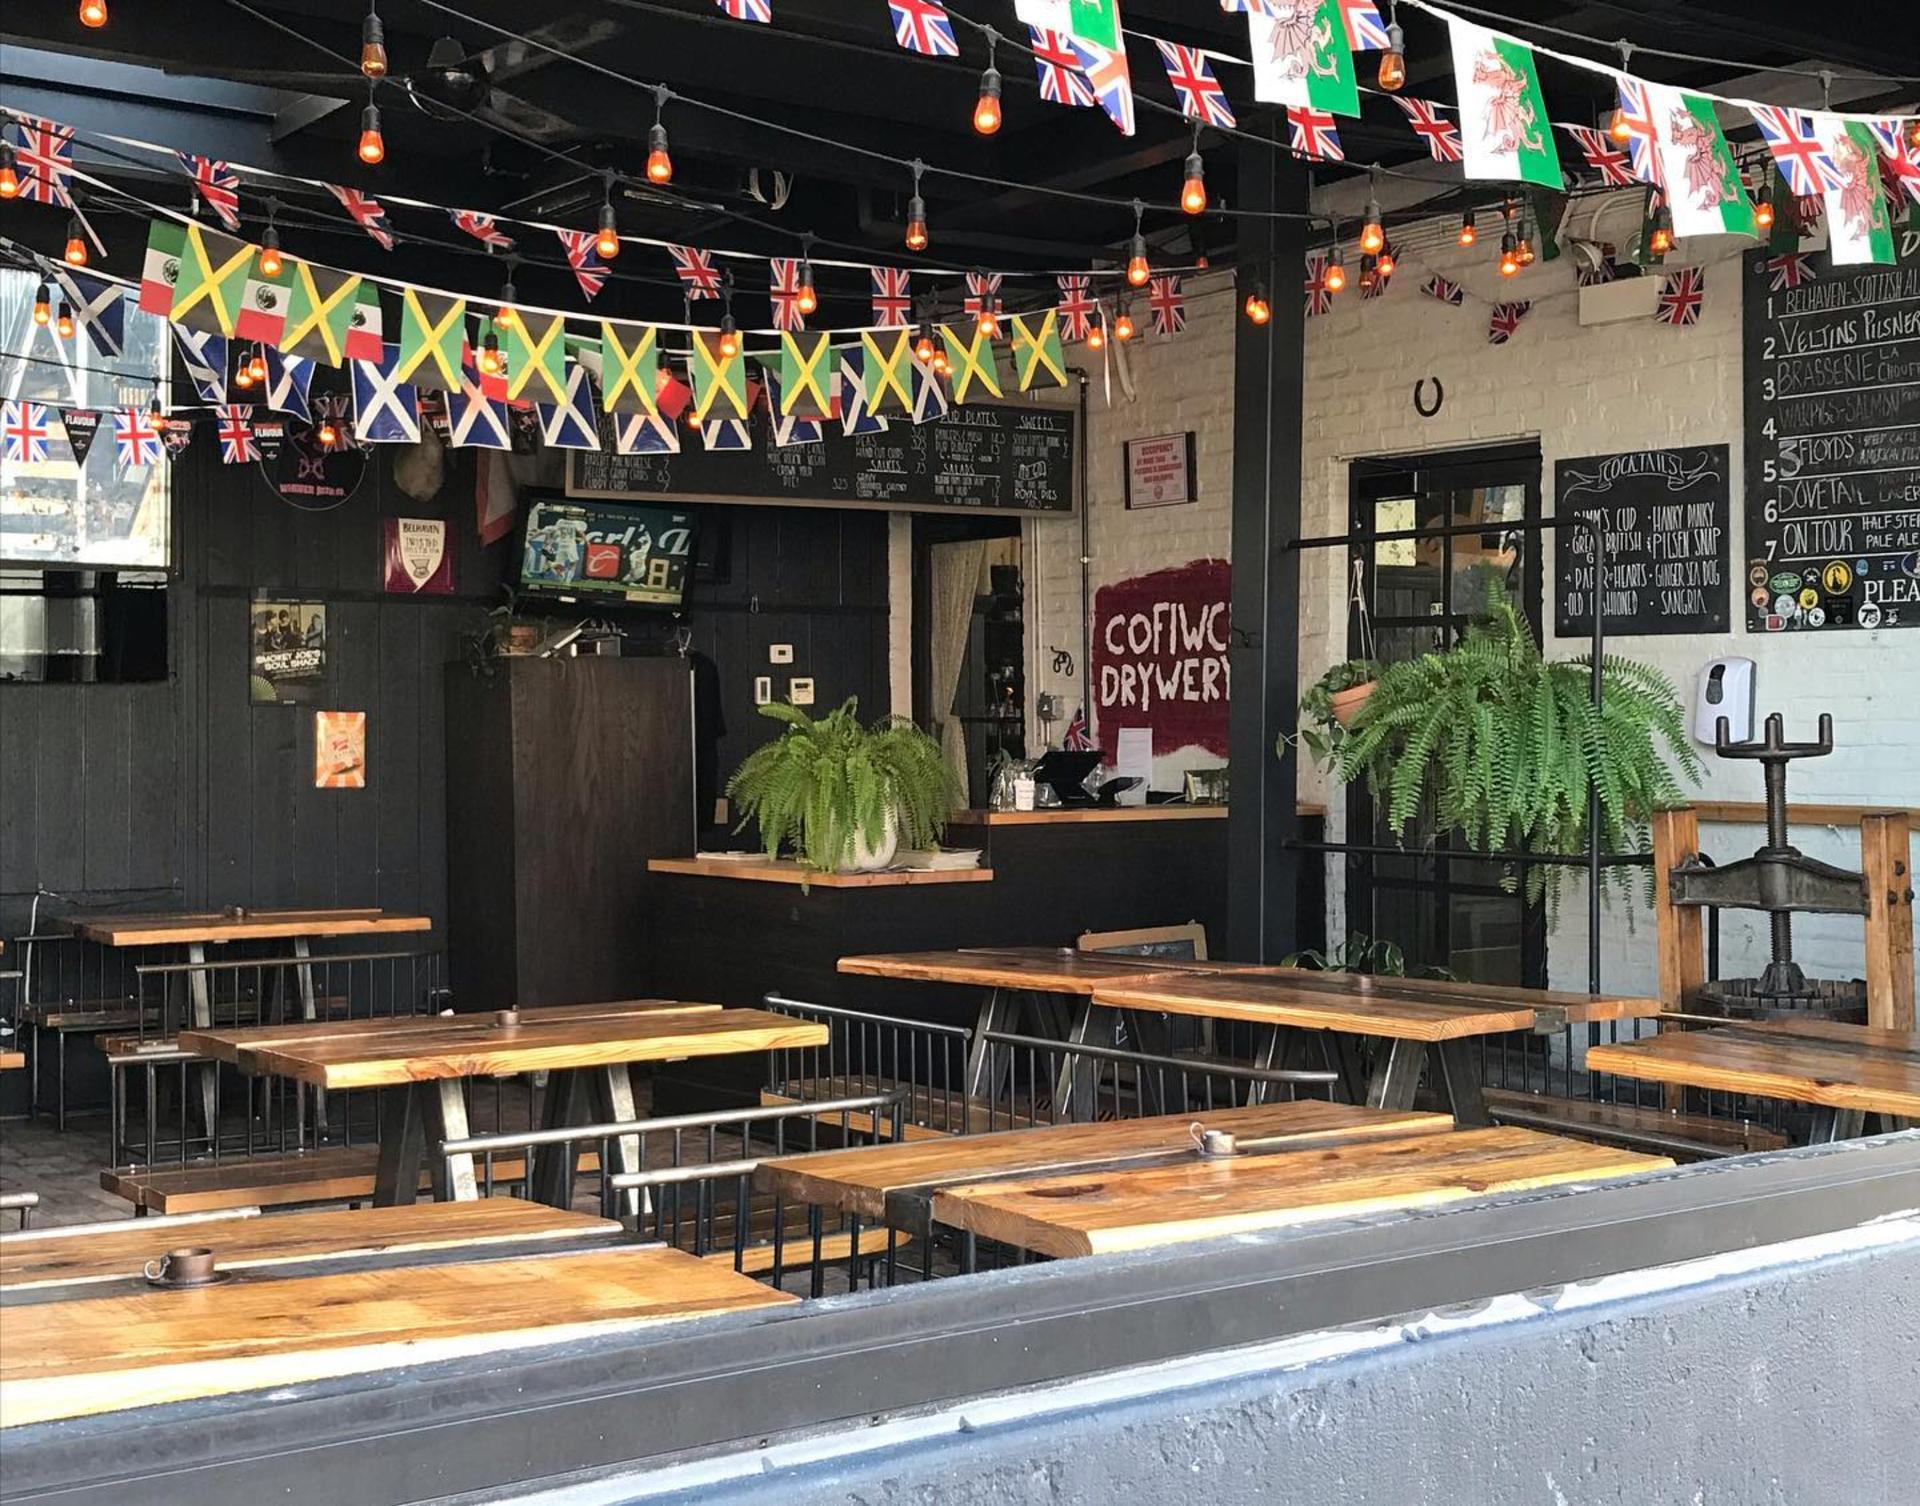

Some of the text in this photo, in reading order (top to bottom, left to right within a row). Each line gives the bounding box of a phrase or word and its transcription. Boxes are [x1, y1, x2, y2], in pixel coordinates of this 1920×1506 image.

[1767, 297, 1773, 319] 1
[1904, 268, 1920, 296] AL
[1763, 310, 1920, 360] 2 VELTINS PILSNER
[1880, 347, 1900, 360] LA
[1763, 378, 1776, 401] 3
[1777, 352, 1876, 394] BRASSERIE
[65, 414, 97, 427] FLAVOUR
[254, 427, 284, 438] FLAVOUR
[1762, 418, 1777, 441] 4
[1603, 452, 1678, 481] COCKTAILS
[1763, 460, 1777, 482] 5
[1764, 500, 1778, 523] 6
[1778, 478, 1872, 513] DOVETAIL
[403, 523, 439, 534] BELHAVEN
[1616, 507, 1637, 531] CUP
[1652, 505, 1683, 532] HANKY
[1862, 514, 1892, 530] HALF
[1572, 531, 1642, 554] GREA BRITISH
[1765, 519, 1853, 562] 7 ON TOUR
[1866, 531, 1919, 549] PALE ALE
[1702, 559, 1720, 587] DOG
[1568, 592, 1584, 616] OLD
[1661, 588, 1707, 615] SANGRIA
[1105, 601, 1231, 655] COFIWC
